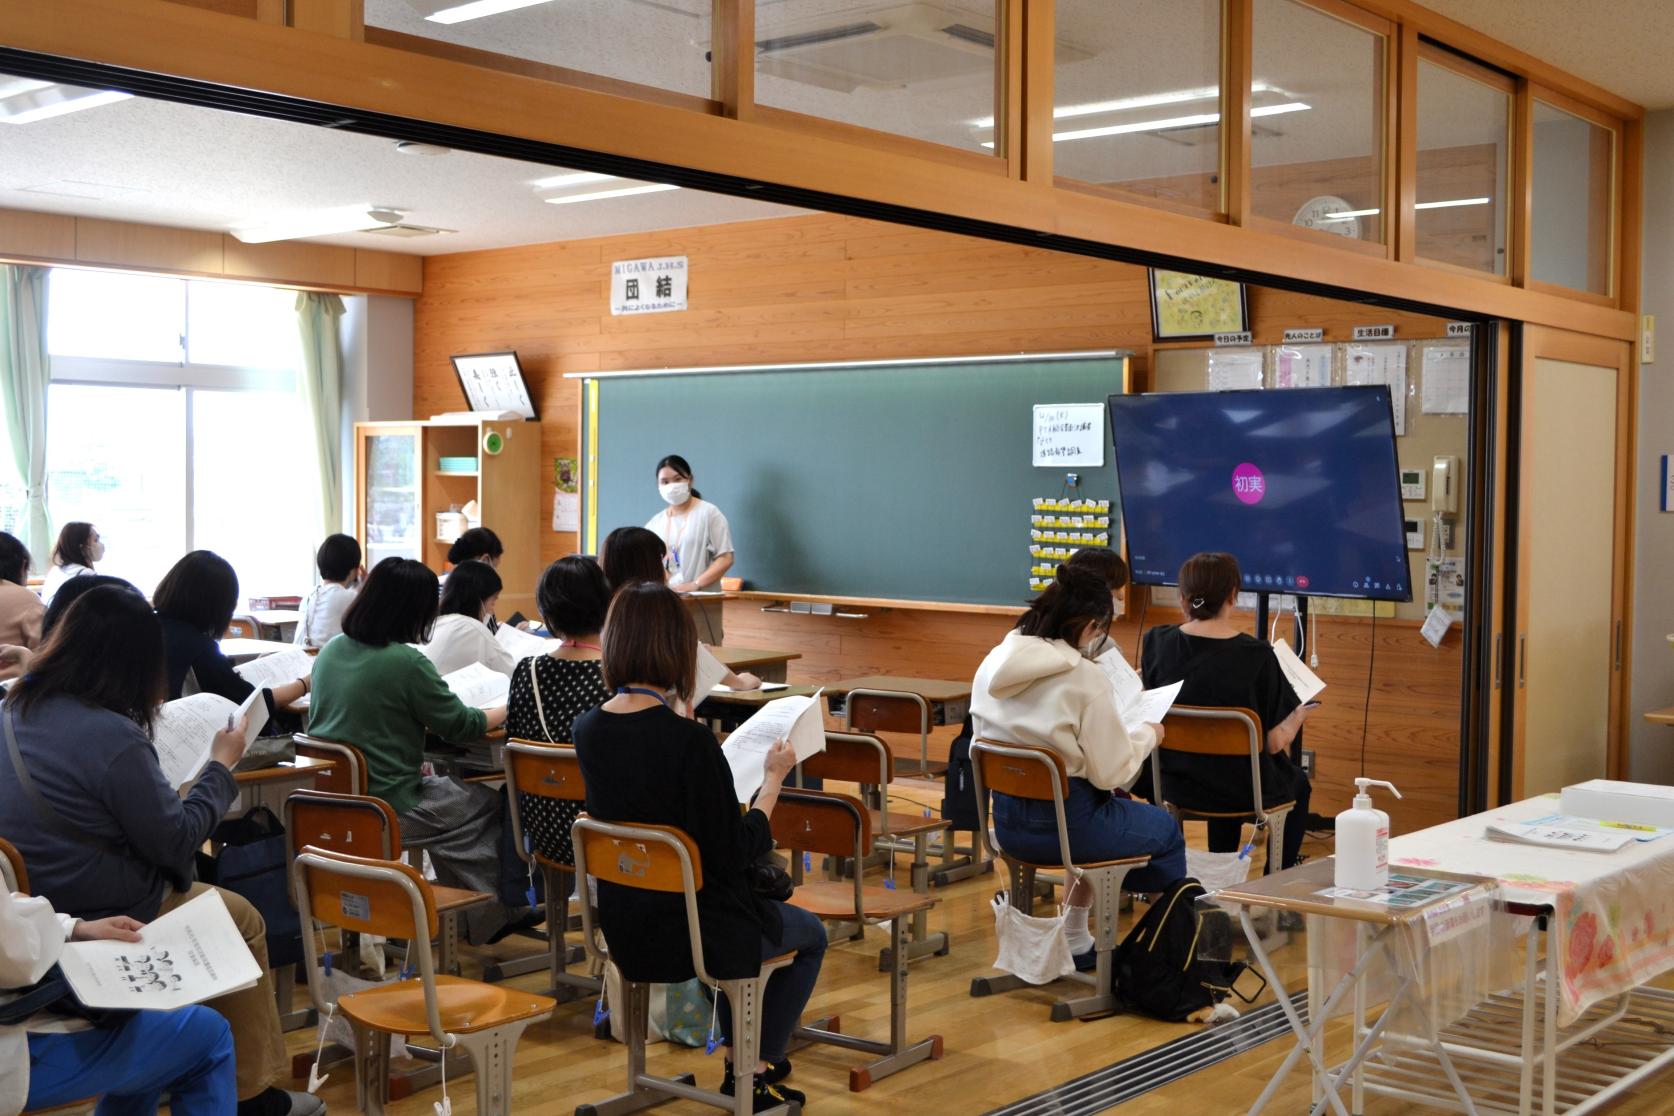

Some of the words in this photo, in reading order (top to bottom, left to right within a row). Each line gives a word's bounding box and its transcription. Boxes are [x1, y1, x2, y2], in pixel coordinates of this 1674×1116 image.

[1357, 327, 1389, 338] 生活目標
[1217, 334, 1249, 344] 今日の予定
[1234, 474, 1263, 493] 初実
